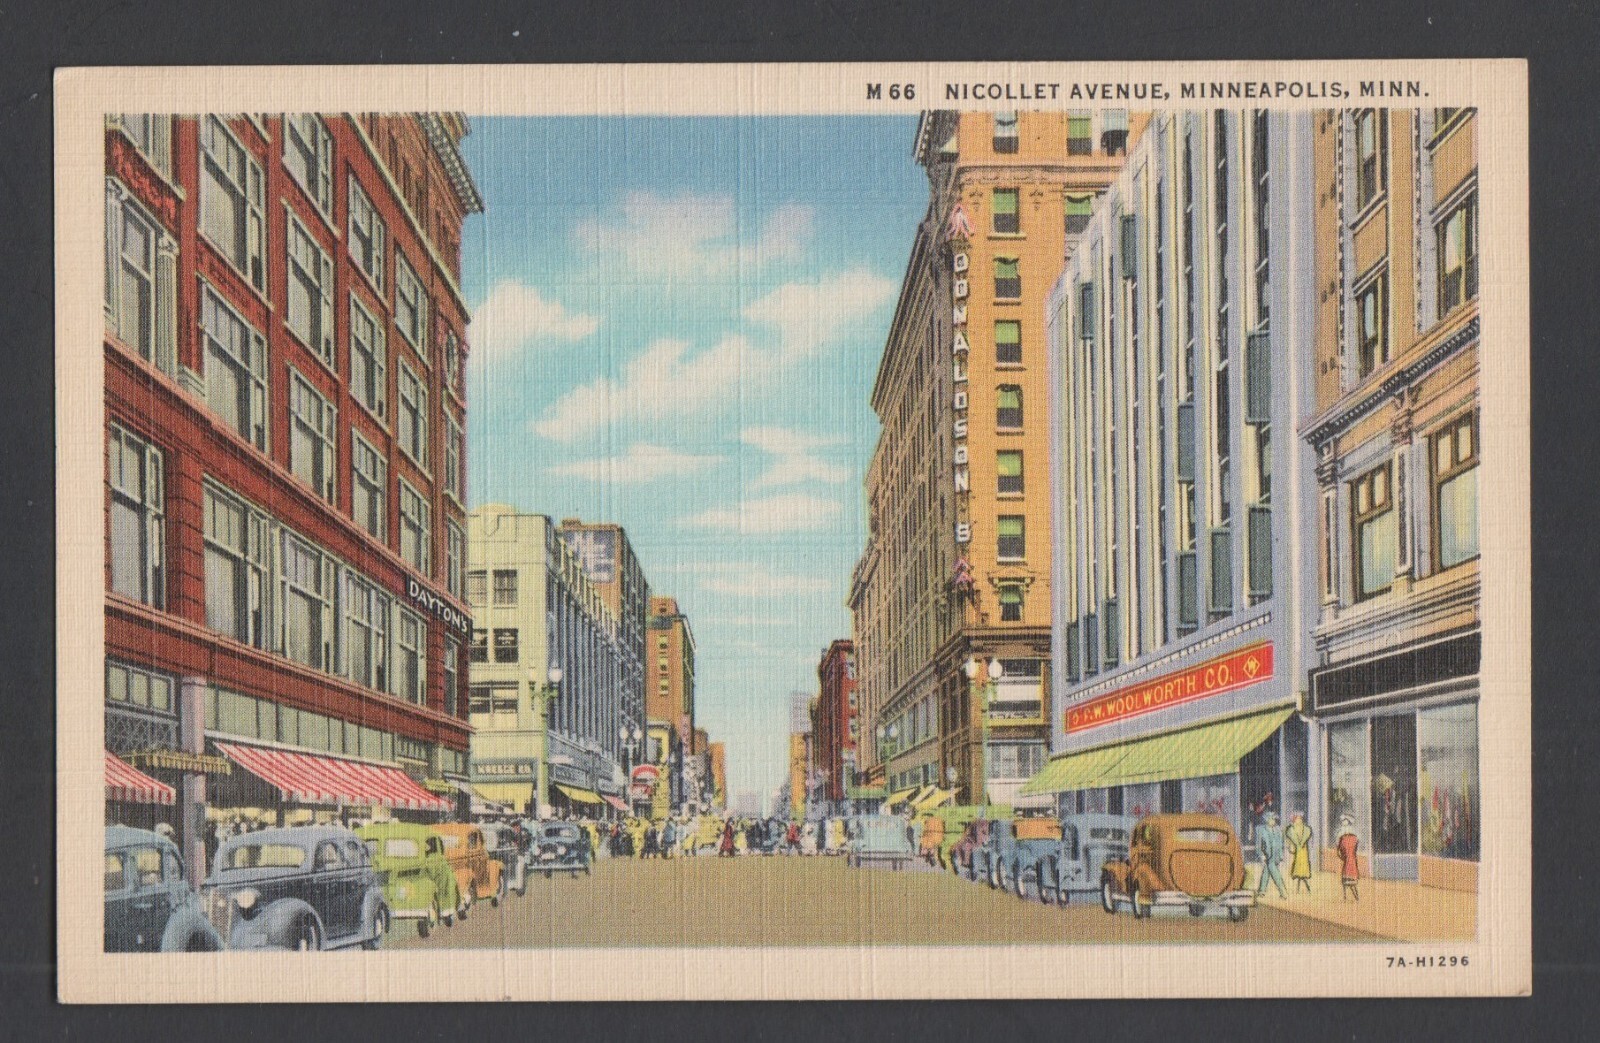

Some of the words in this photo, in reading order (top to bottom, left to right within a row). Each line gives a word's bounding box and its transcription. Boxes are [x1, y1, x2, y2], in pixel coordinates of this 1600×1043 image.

[866, 83, 882, 99] M
[889, 83, 916, 99] 66
[945, 83, 1060, 99] NICOLLET
[1070, 83, 1170, 100] AVENUE,
[1181, 81, 1350, 99] MINNEAPOLIS,
[1359, 80, 1430, 97] MINN.
[409, 580, 468, 632] DAYTON'S
[1106, 676, 1196, 716] WOOLWORTH
[1205, 664, 1233, 688] CO.
[1386, 956, 1469, 968] 7A-H1296
